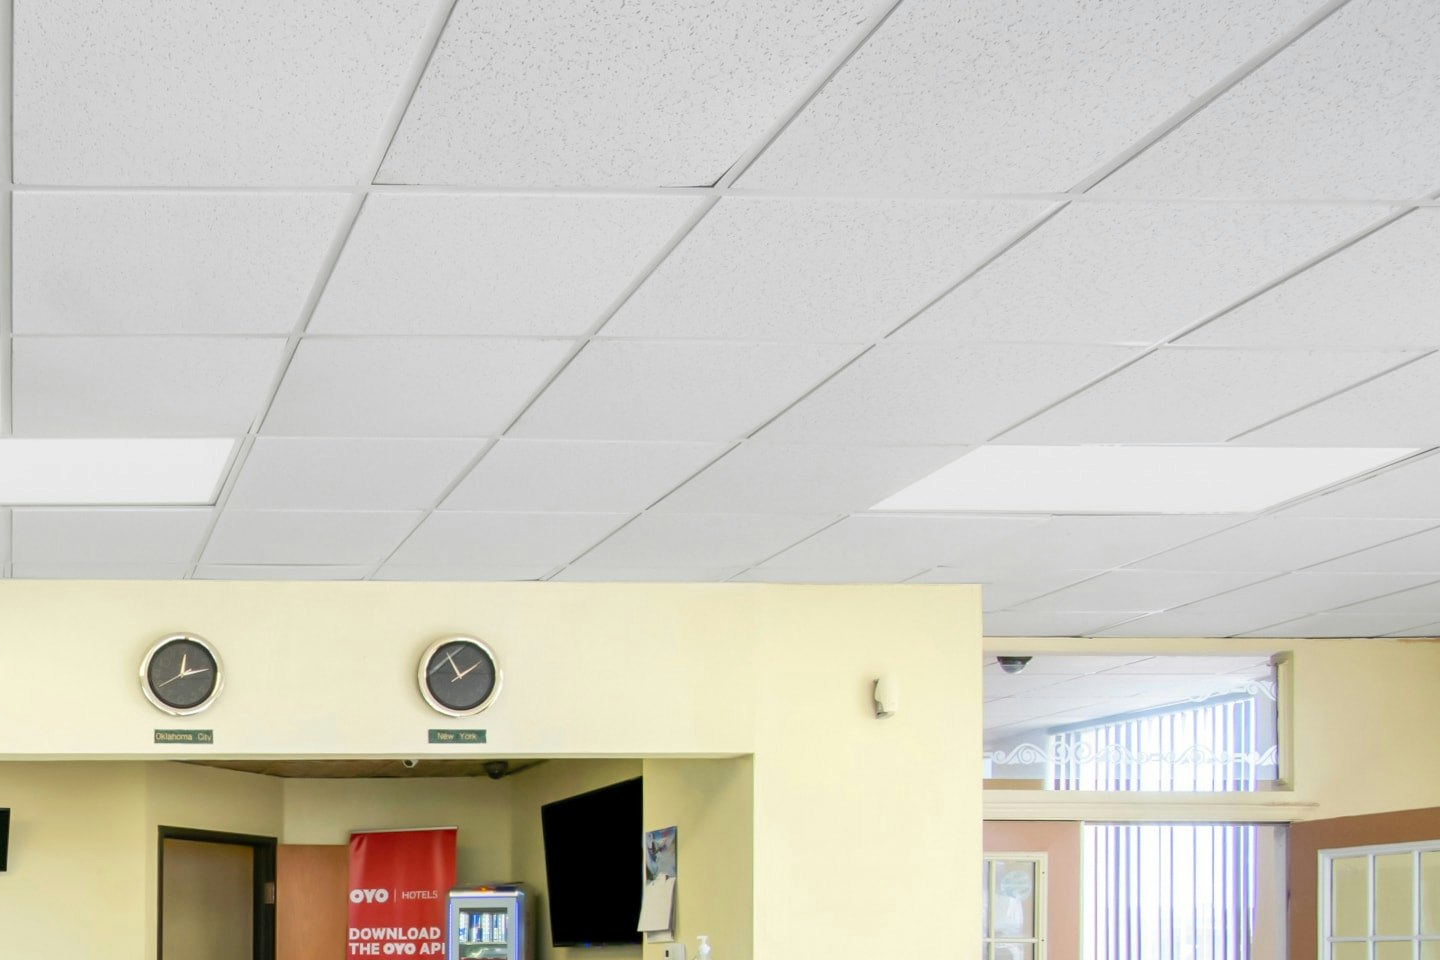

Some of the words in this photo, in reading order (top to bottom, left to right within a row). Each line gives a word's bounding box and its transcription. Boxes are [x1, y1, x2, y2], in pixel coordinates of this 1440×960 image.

[155, 732, 193, 741] Oklahoma
[197, 733, 212, 742] City
[437, 732, 455, 741] New
[459, 732, 478, 740] York
[349, 888, 389, 904] OYO
[401, 890, 438, 900] HOTELS
[348, 927, 441, 941] DOWNLOAD
[349, 943, 380, 956] THE
[383, 943, 416, 956] OYO
